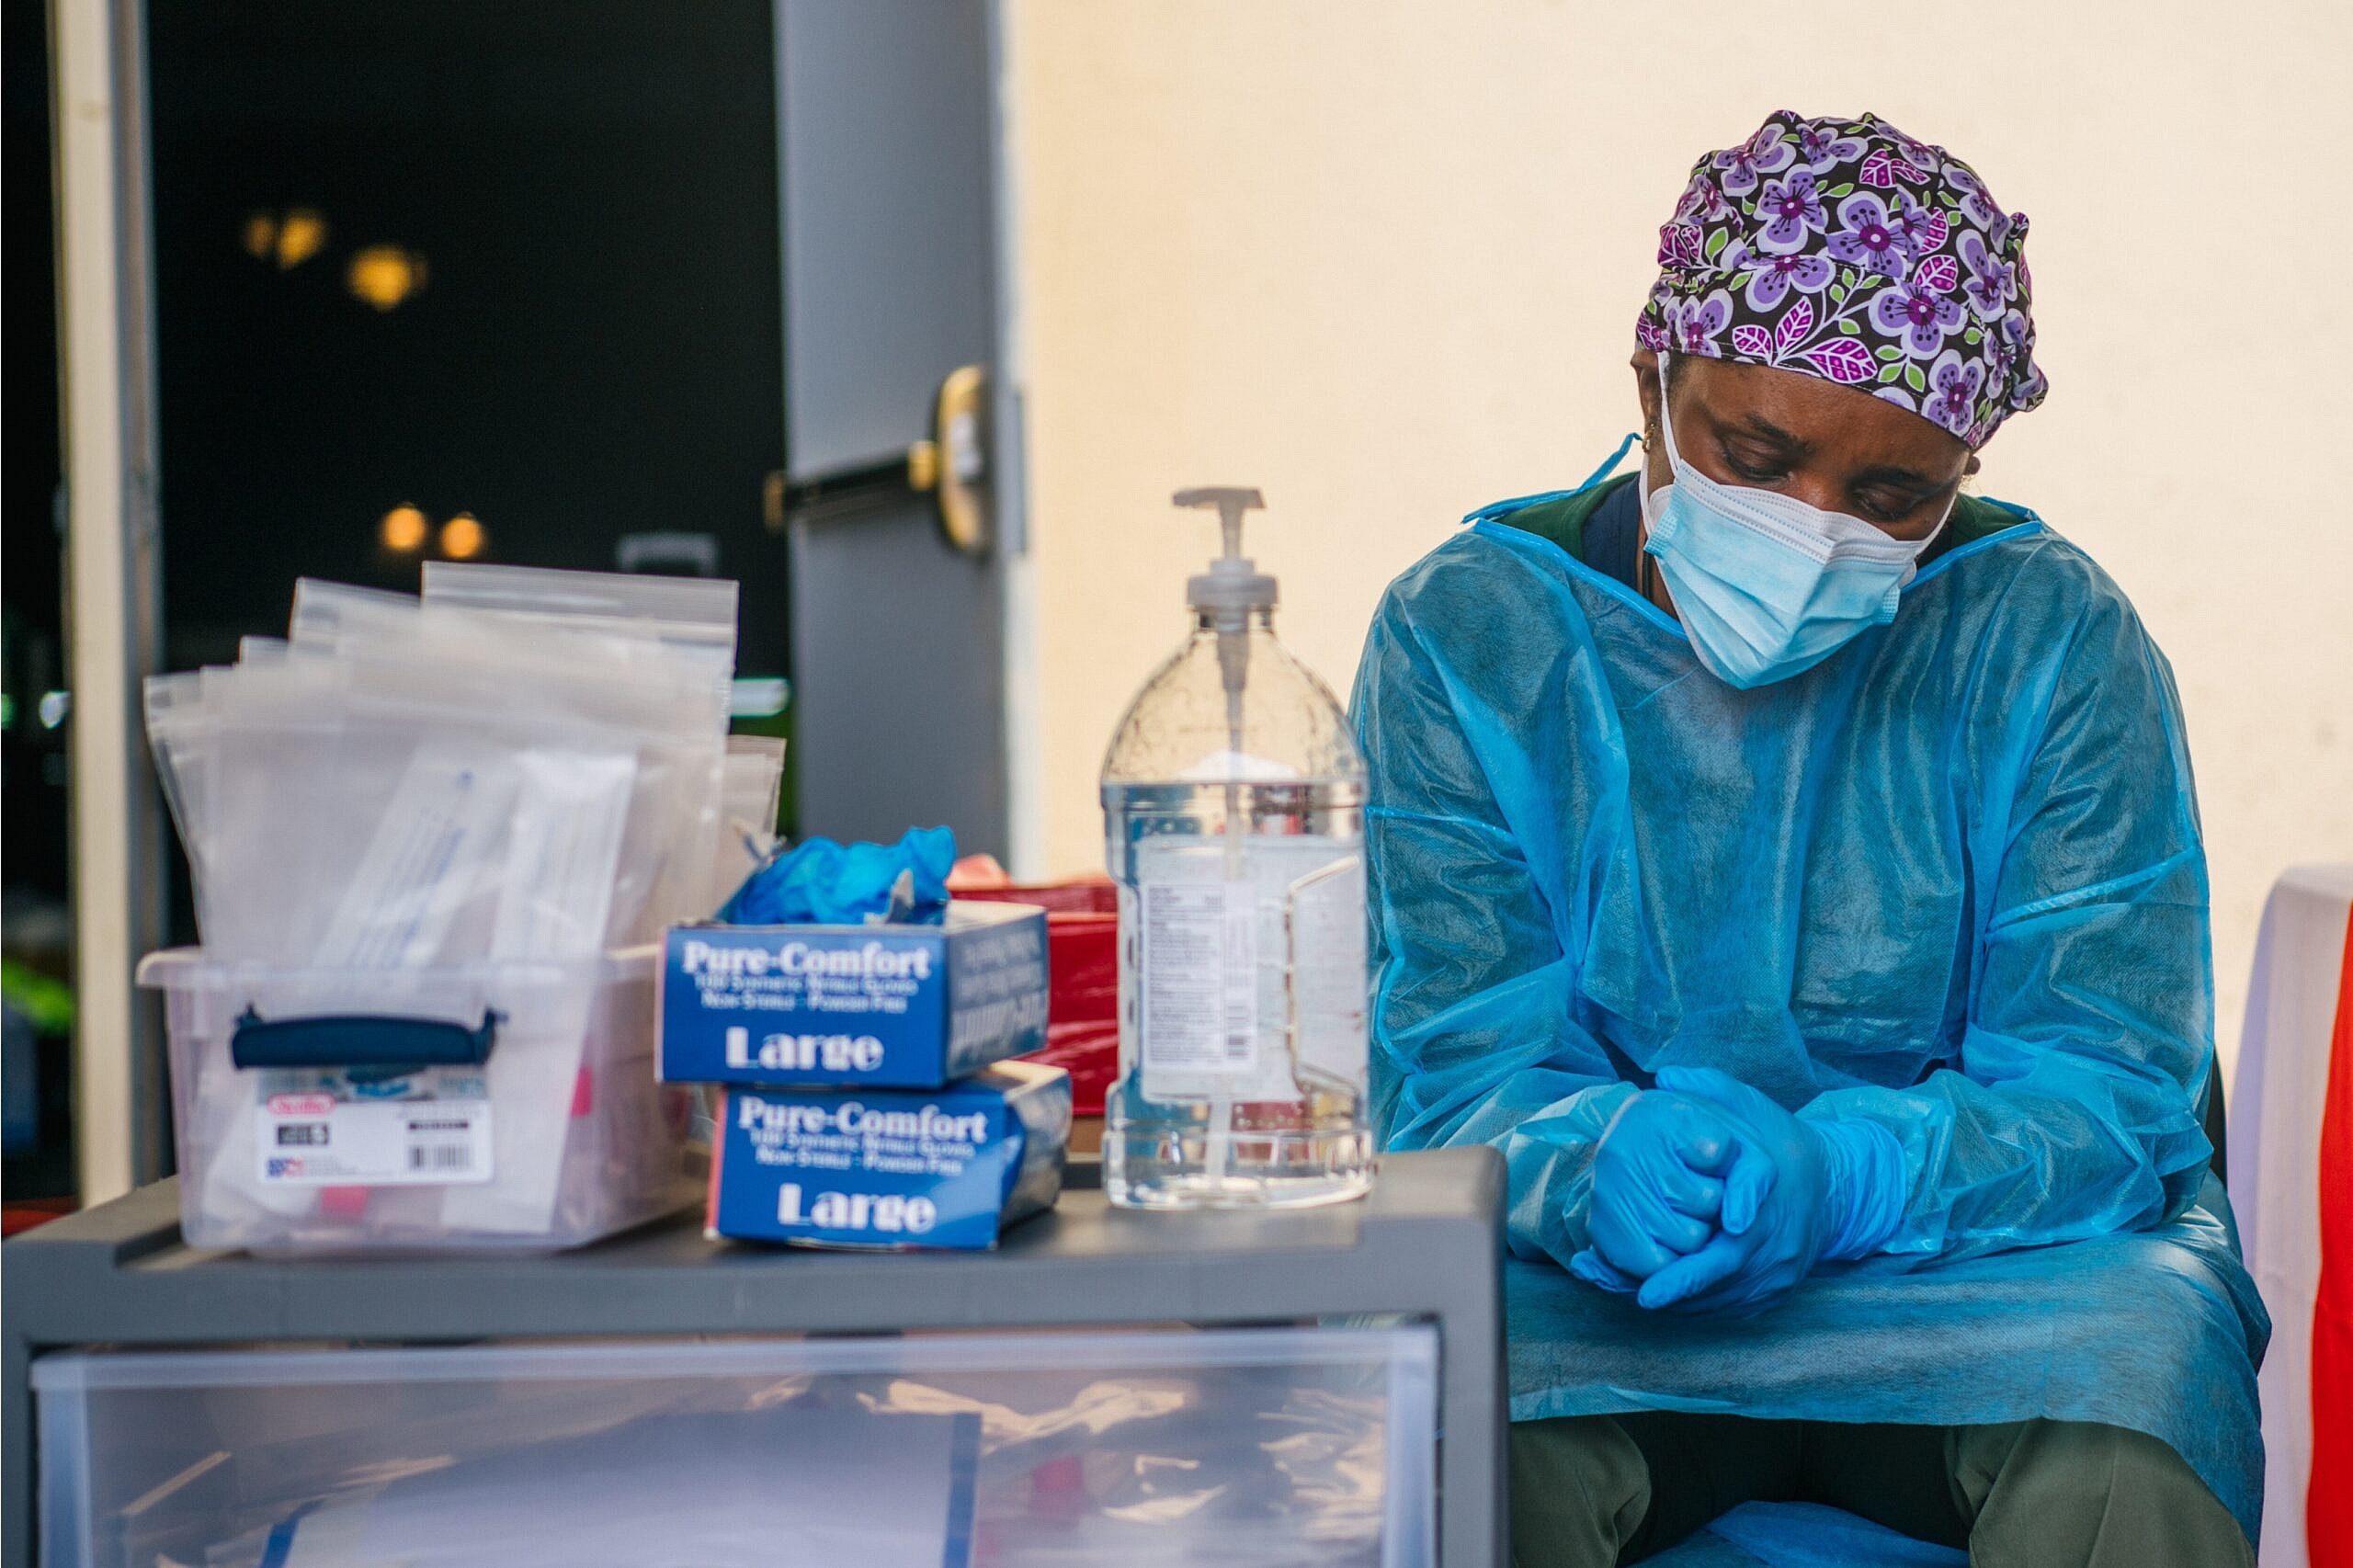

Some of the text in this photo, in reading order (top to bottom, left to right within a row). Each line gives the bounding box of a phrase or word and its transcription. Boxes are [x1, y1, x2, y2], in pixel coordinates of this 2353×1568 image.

[684, 940, 931, 979] Pure-Comfort
[725, 1027, 883, 1071] Large
[738, 1095, 988, 1144] Pure-Comfort
[777, 1183, 938, 1233] Large
